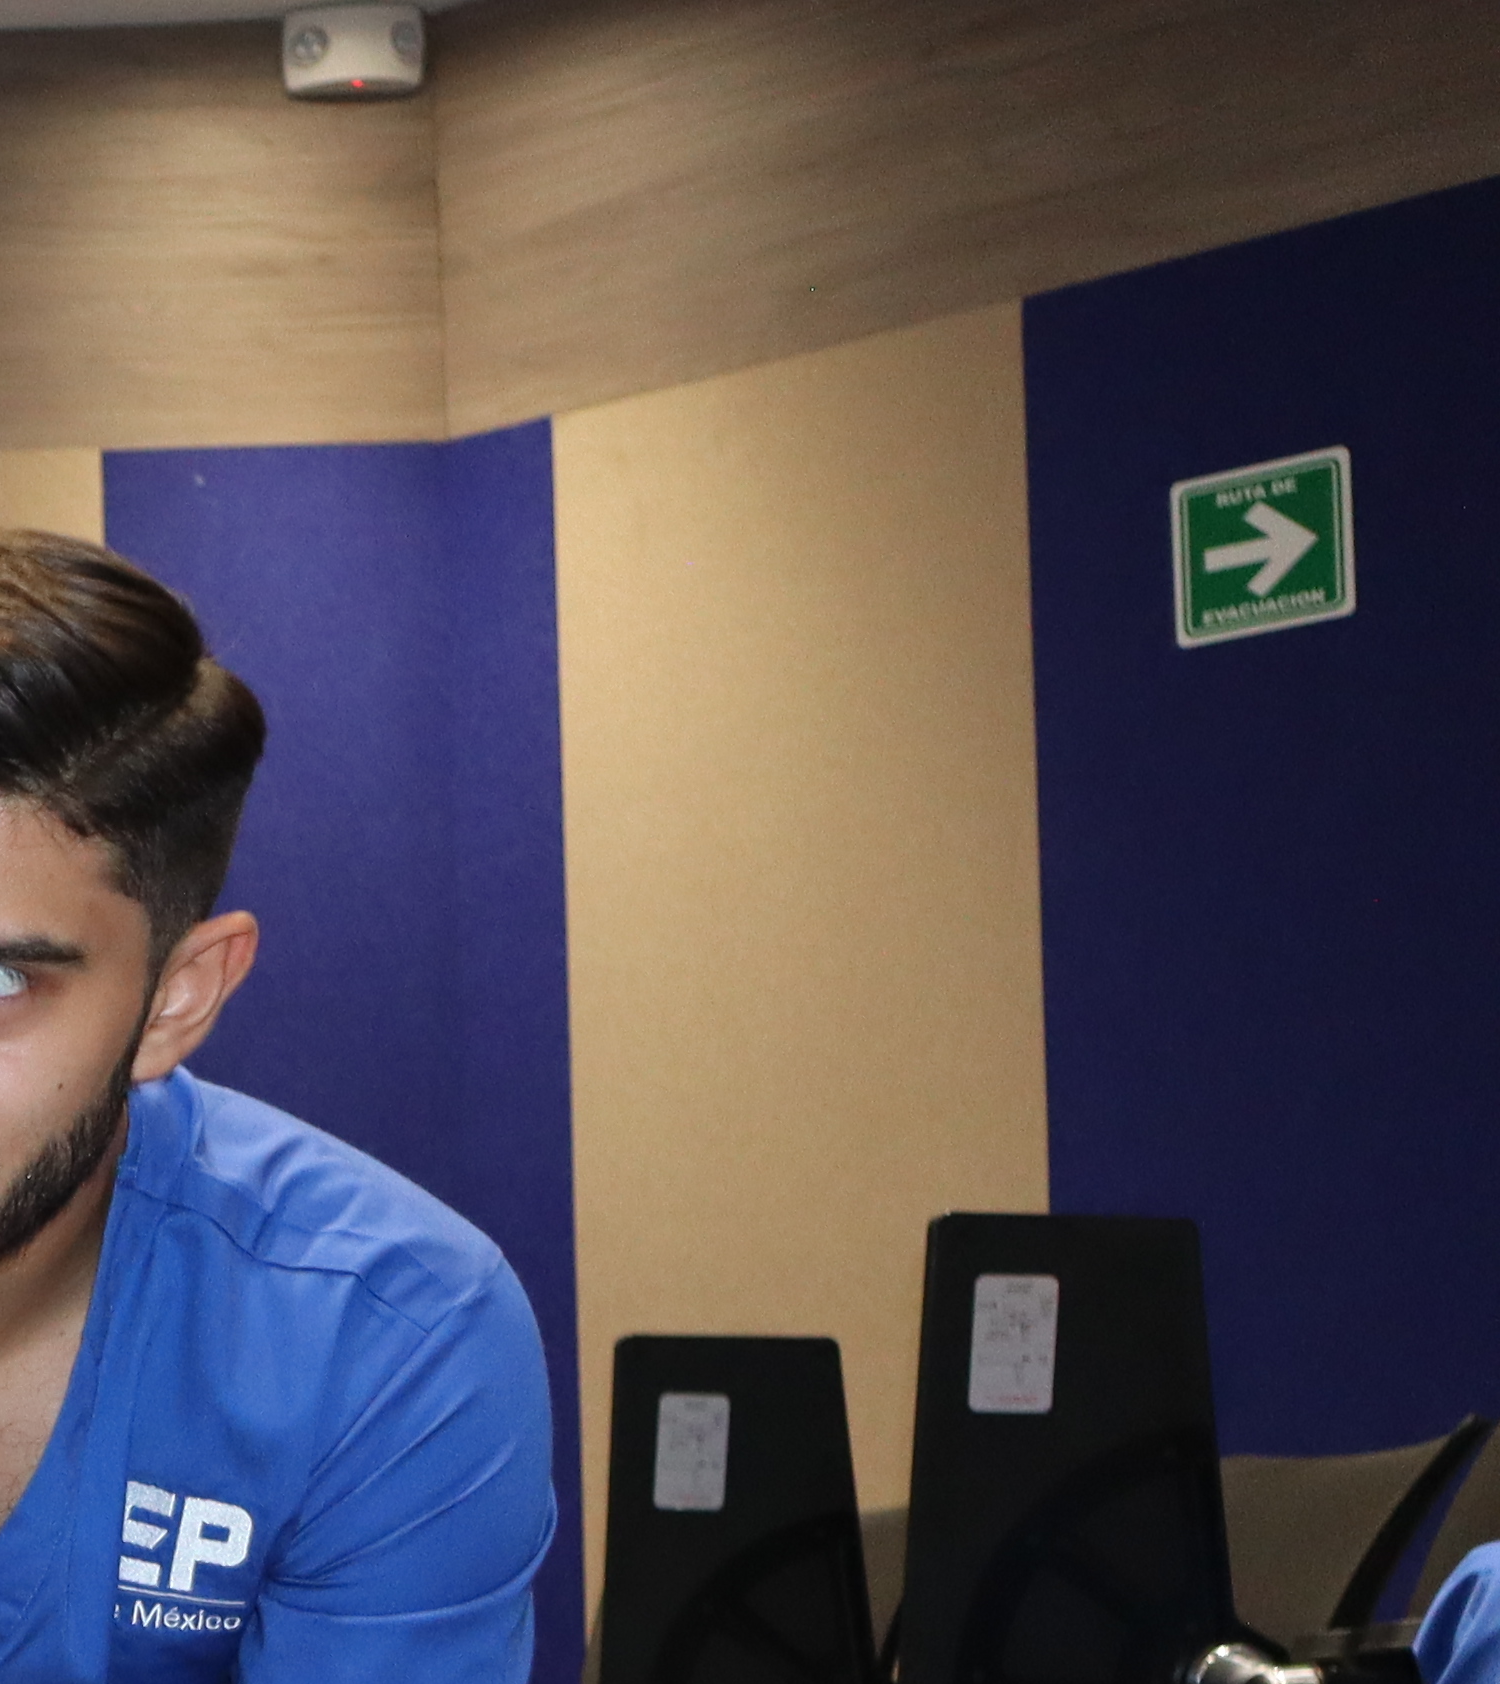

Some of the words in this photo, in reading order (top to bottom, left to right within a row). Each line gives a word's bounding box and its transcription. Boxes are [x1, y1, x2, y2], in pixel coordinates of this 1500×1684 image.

[1216, 483, 1267, 508] RUTA
[1271, 477, 1297, 496] DE
[131, 1600, 242, 1631] México
